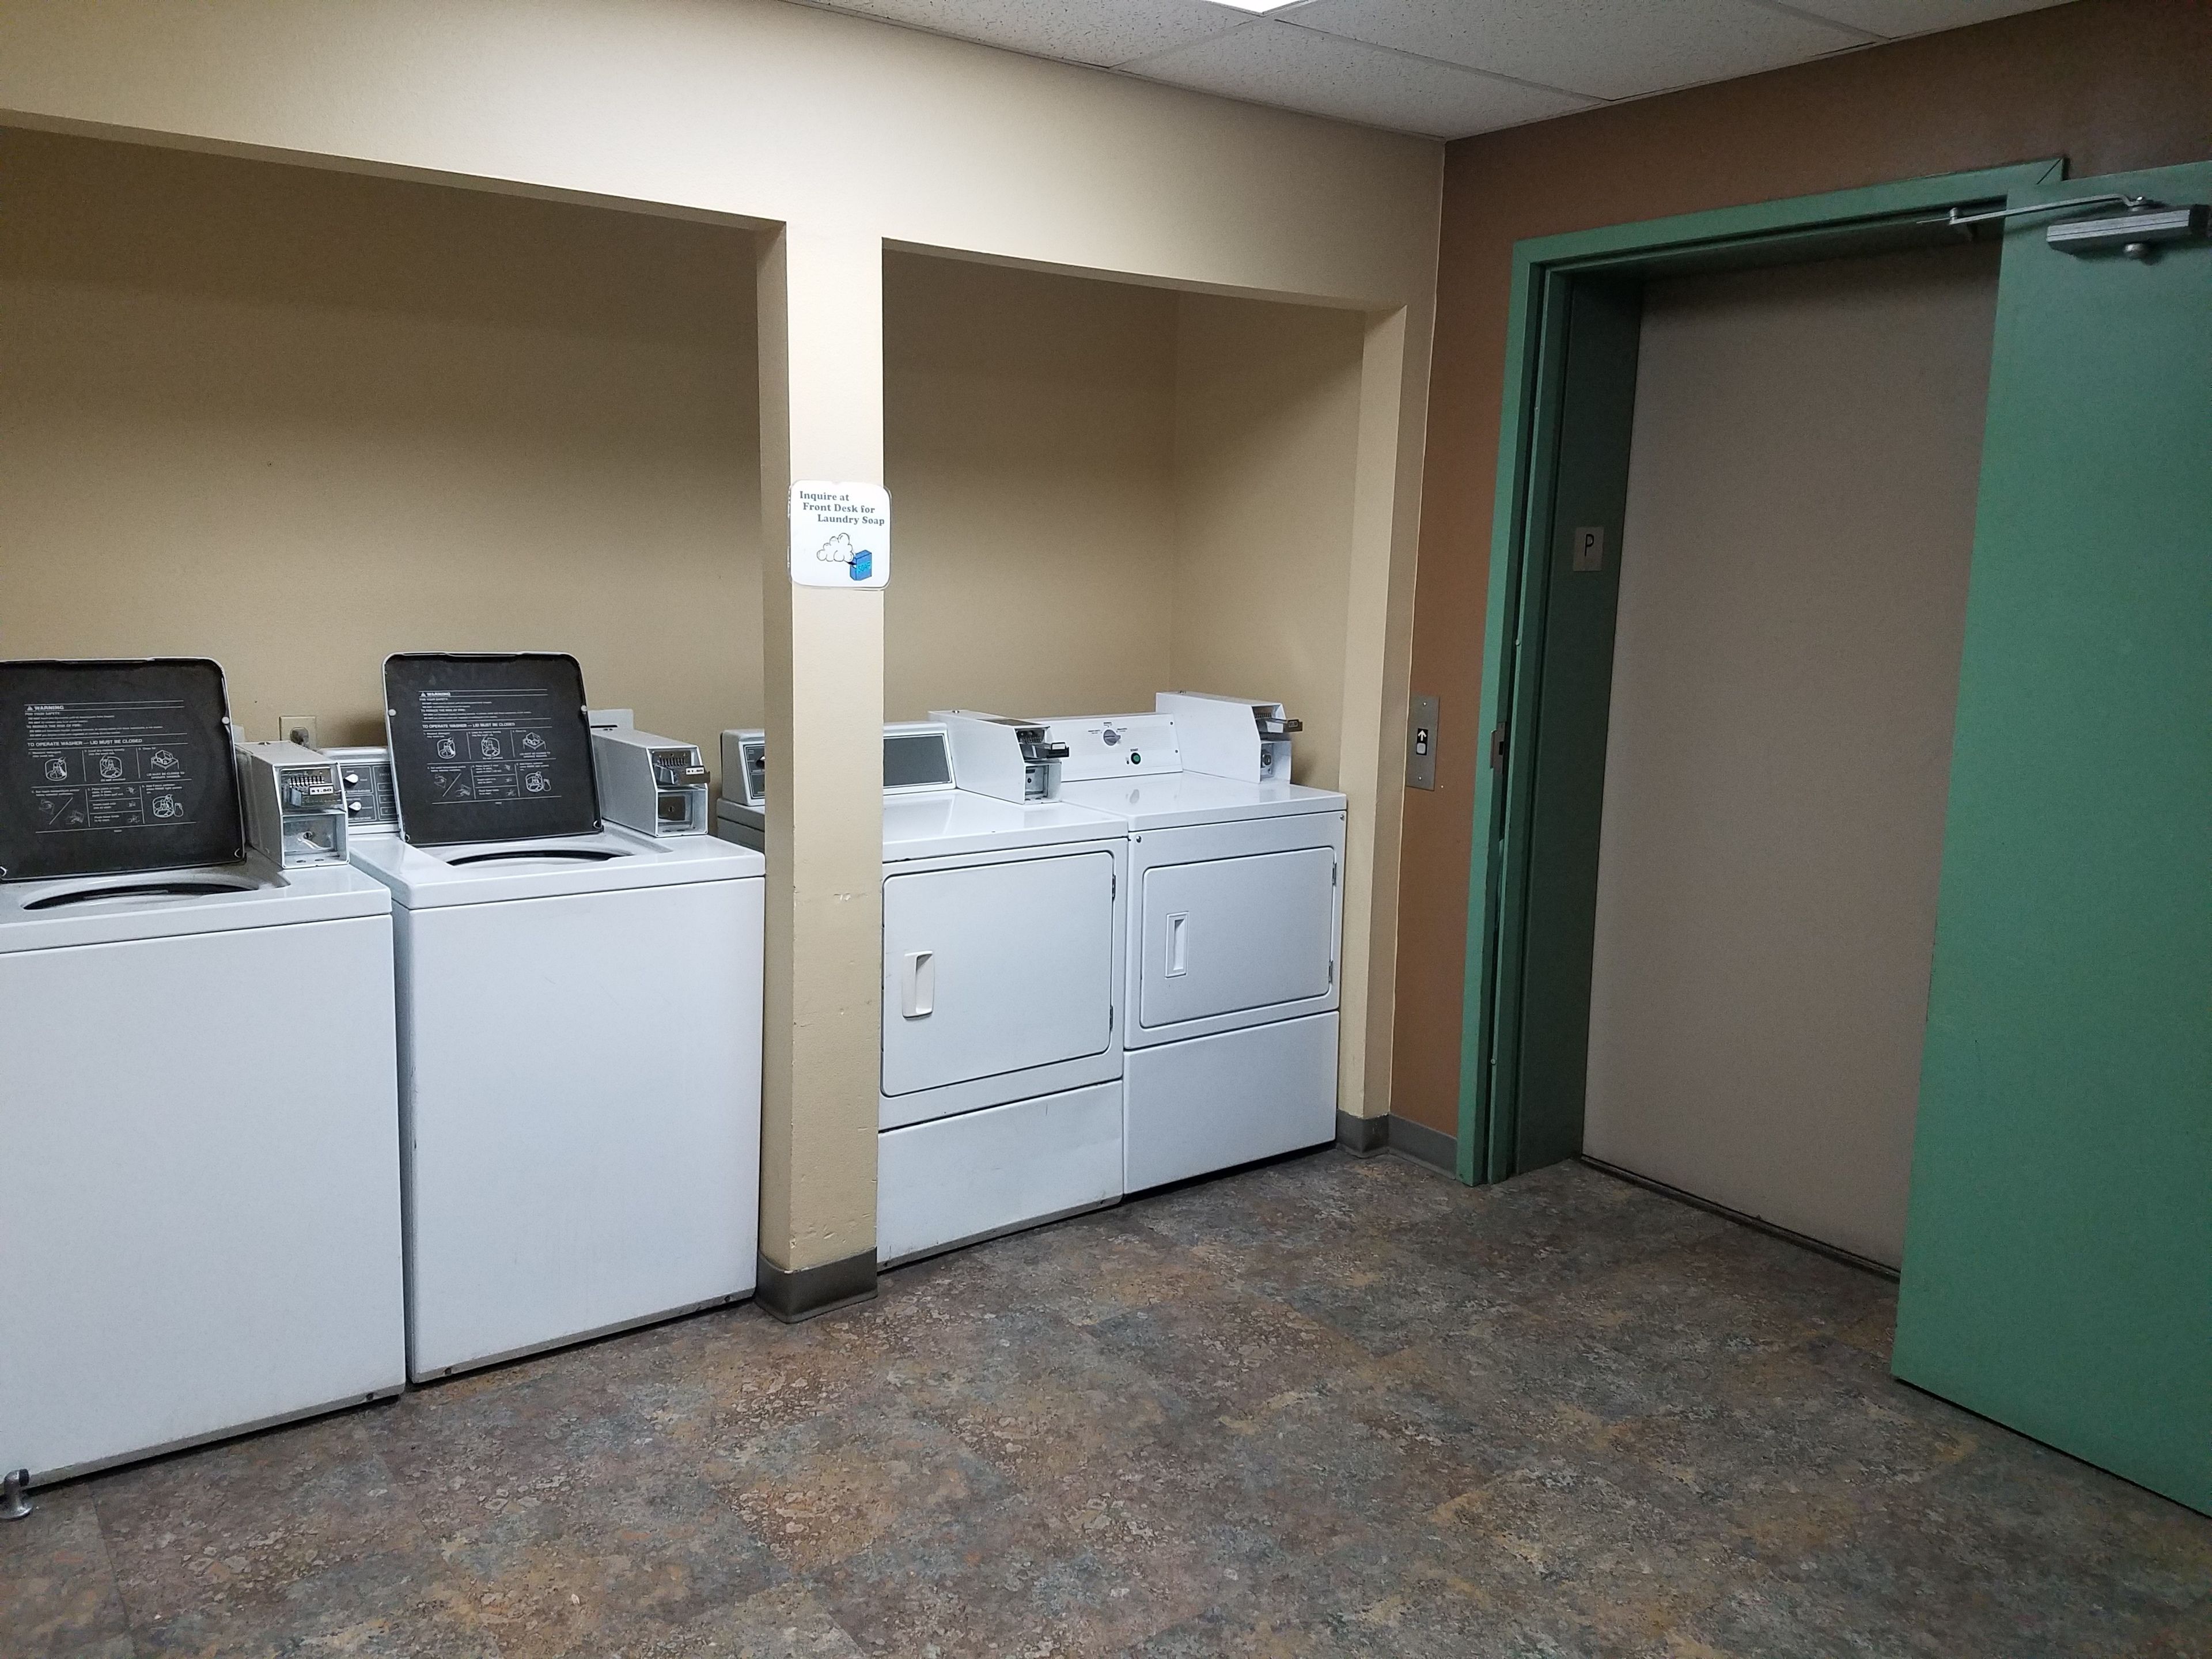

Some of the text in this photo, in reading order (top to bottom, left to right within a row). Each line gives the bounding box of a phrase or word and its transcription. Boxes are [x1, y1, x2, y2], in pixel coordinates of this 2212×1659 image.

[800, 491, 836, 501] Inquire
[803, 502, 875, 513] Front Desk for
[817, 514, 885, 526] Laundry Soap
[1585, 533, 1594, 557] P
